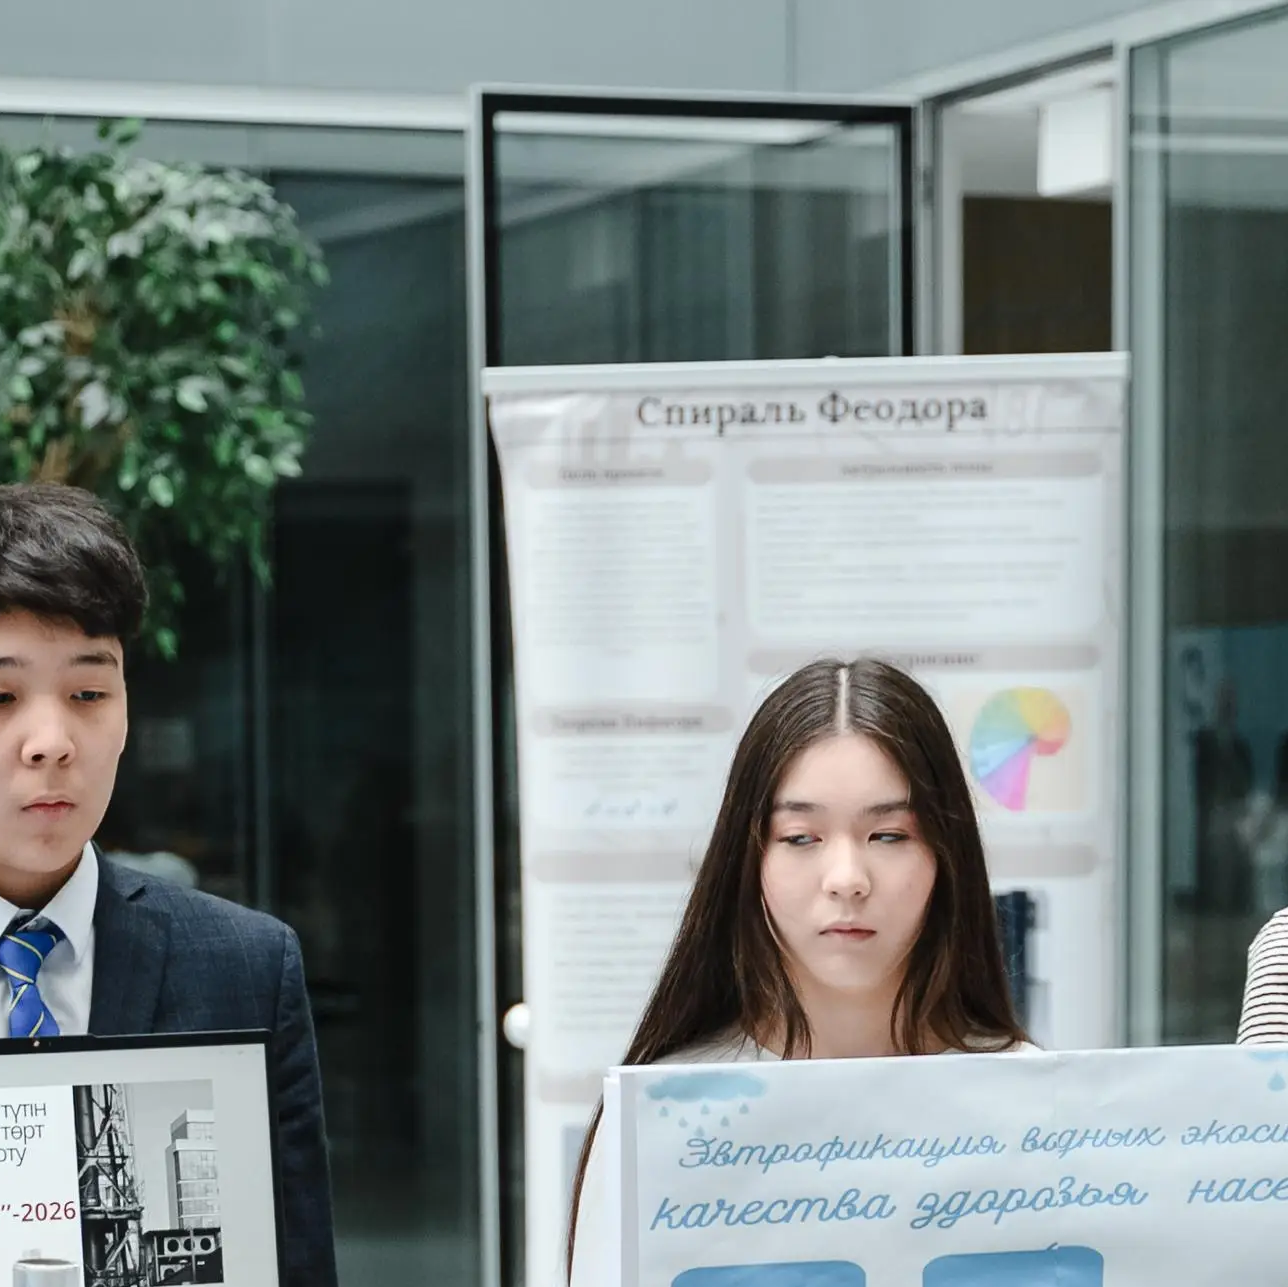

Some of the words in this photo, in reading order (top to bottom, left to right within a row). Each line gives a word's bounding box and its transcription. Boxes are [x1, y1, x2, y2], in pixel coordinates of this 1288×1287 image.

[636, 396, 807, 438] Спираль
[817, 390, 989, 432] Феодора
[1, 1102, 47, 1124] түтін
[1, 1124, 45, 1145] төрт
[678, 1133, 1007, 1175] Эвтрофикация
[649, 1188, 897, 1231] качества
